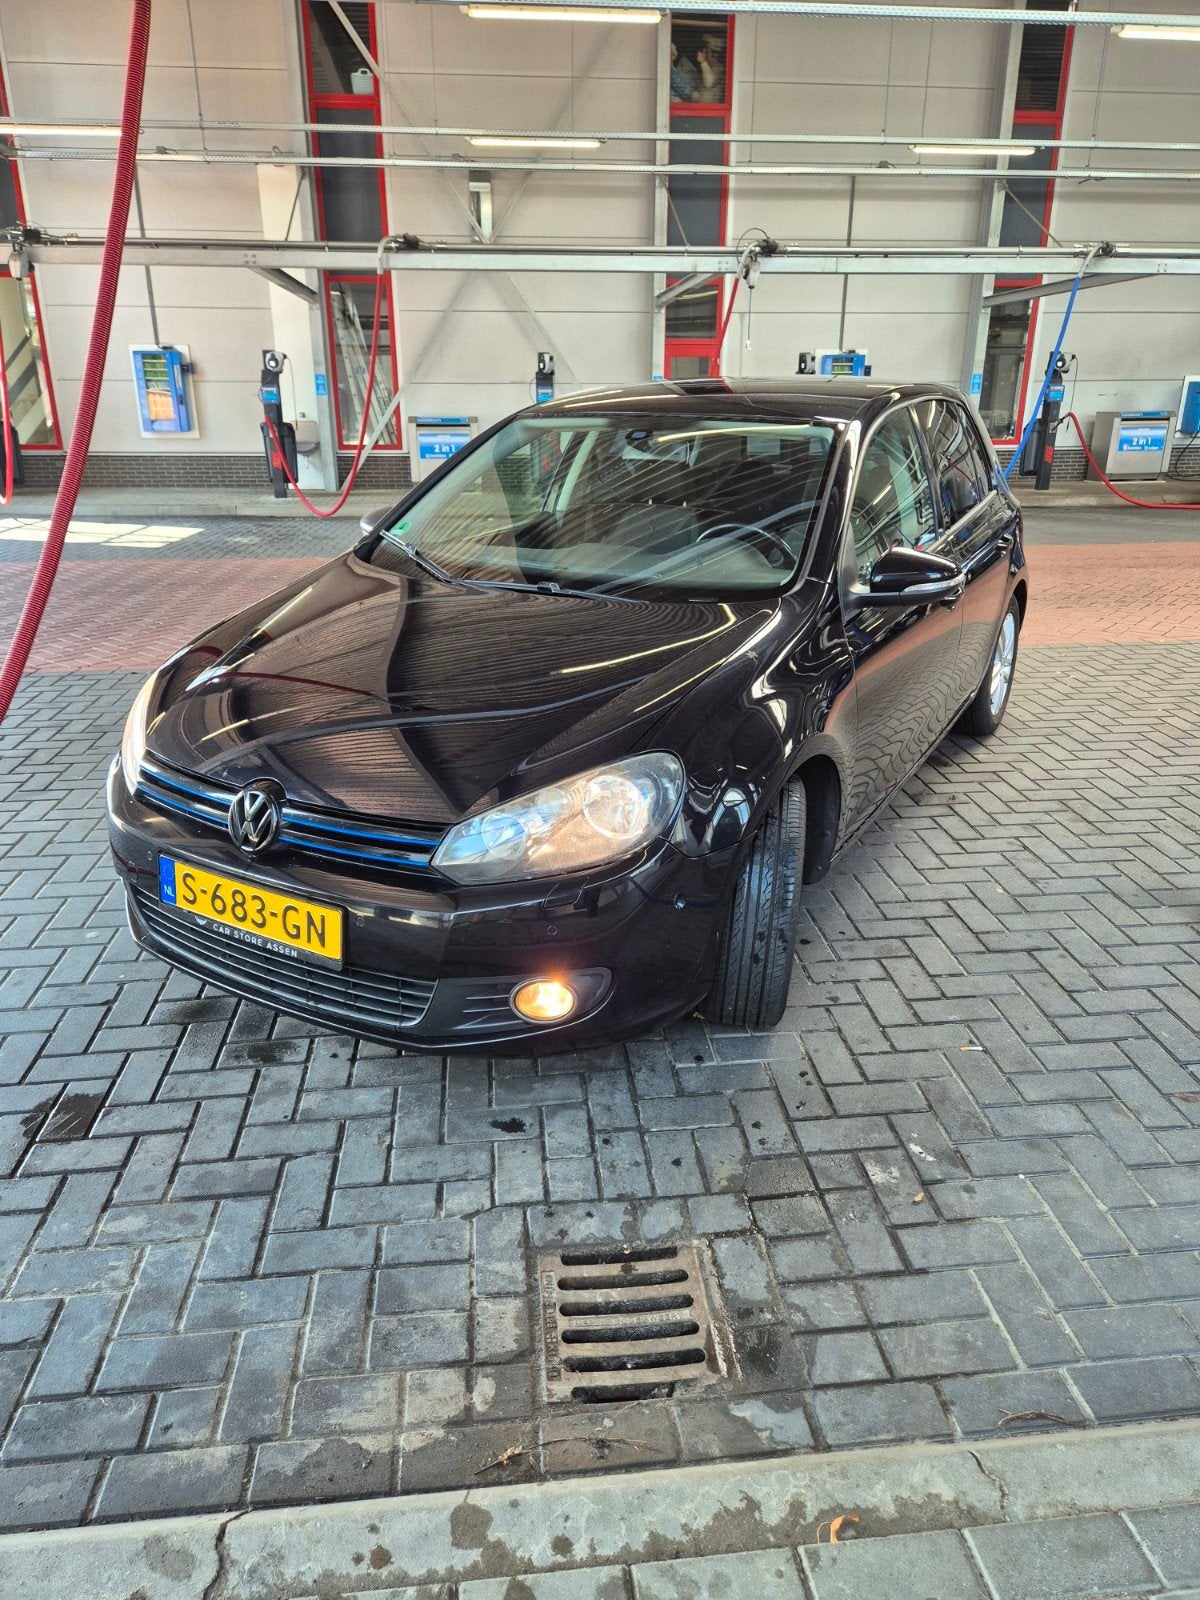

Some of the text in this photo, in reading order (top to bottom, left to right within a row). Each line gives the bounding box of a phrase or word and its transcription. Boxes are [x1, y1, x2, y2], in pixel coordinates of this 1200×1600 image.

[1132, 437, 1138, 445] 2
[1138, 437, 1146, 445] in
[434, 444, 440, 453] 2
[441, 444, 450, 453] in
[164, 884, 175, 897] NL
[181, 872, 327, 949] S-683-GN
[212, 923, 298, 958] CAR STORE ASSEN
